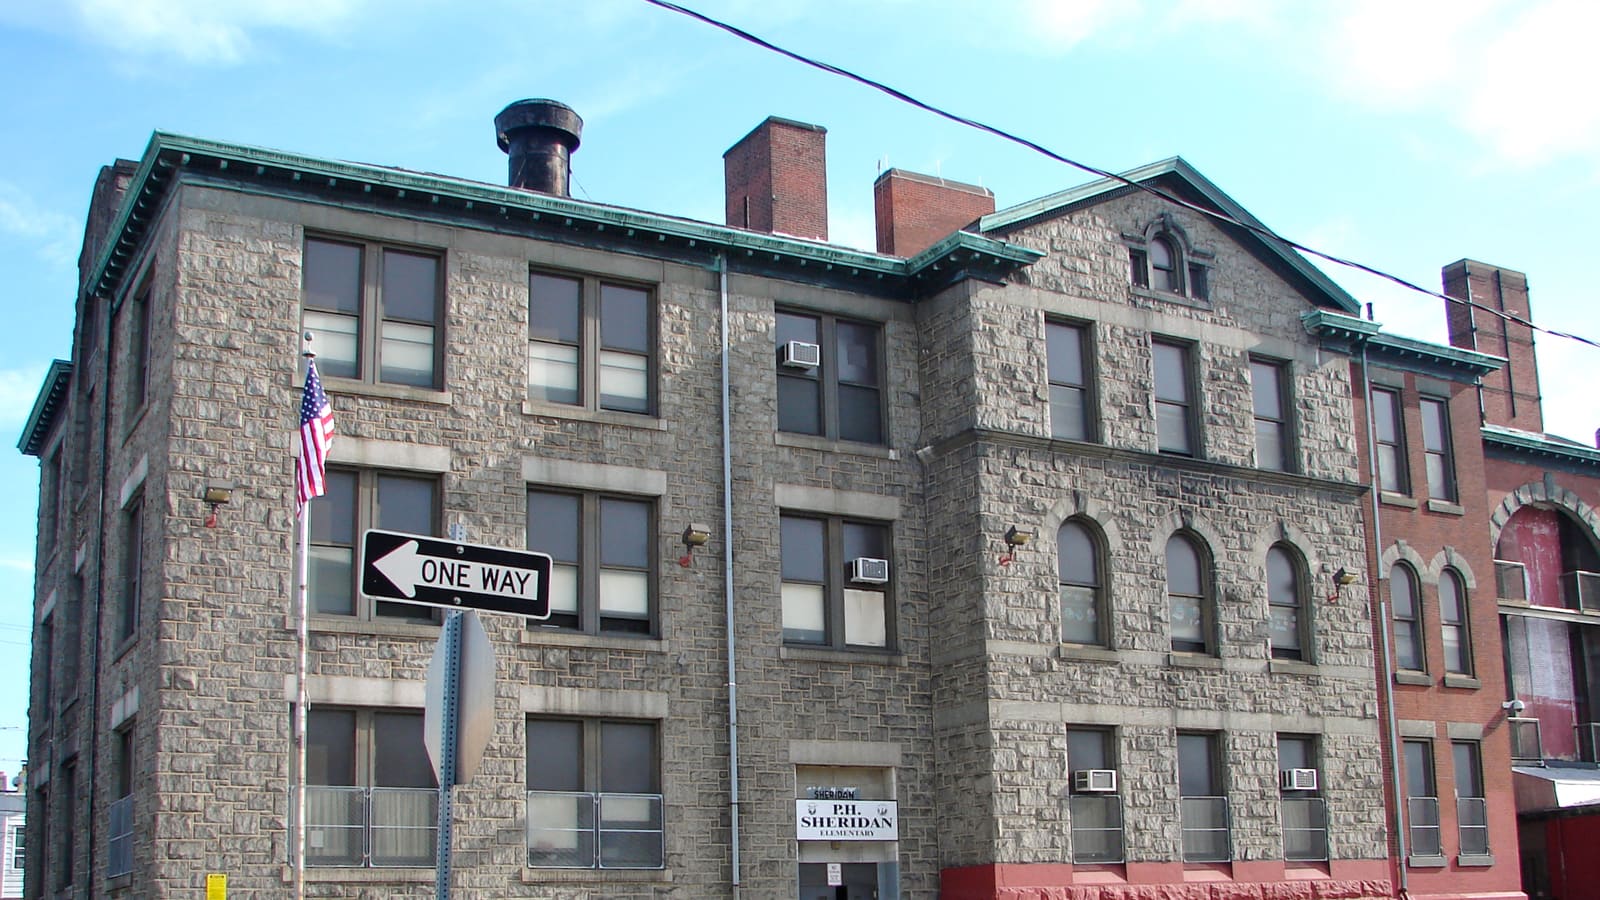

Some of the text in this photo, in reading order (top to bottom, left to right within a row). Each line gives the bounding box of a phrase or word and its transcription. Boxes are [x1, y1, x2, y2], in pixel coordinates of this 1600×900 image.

[422, 559, 531, 595] ONE WAY
[814, 790, 855, 799] SHERIDAN
[833, 804, 861, 815] P.H.
[801, 817, 893, 828] SHERIDAN
